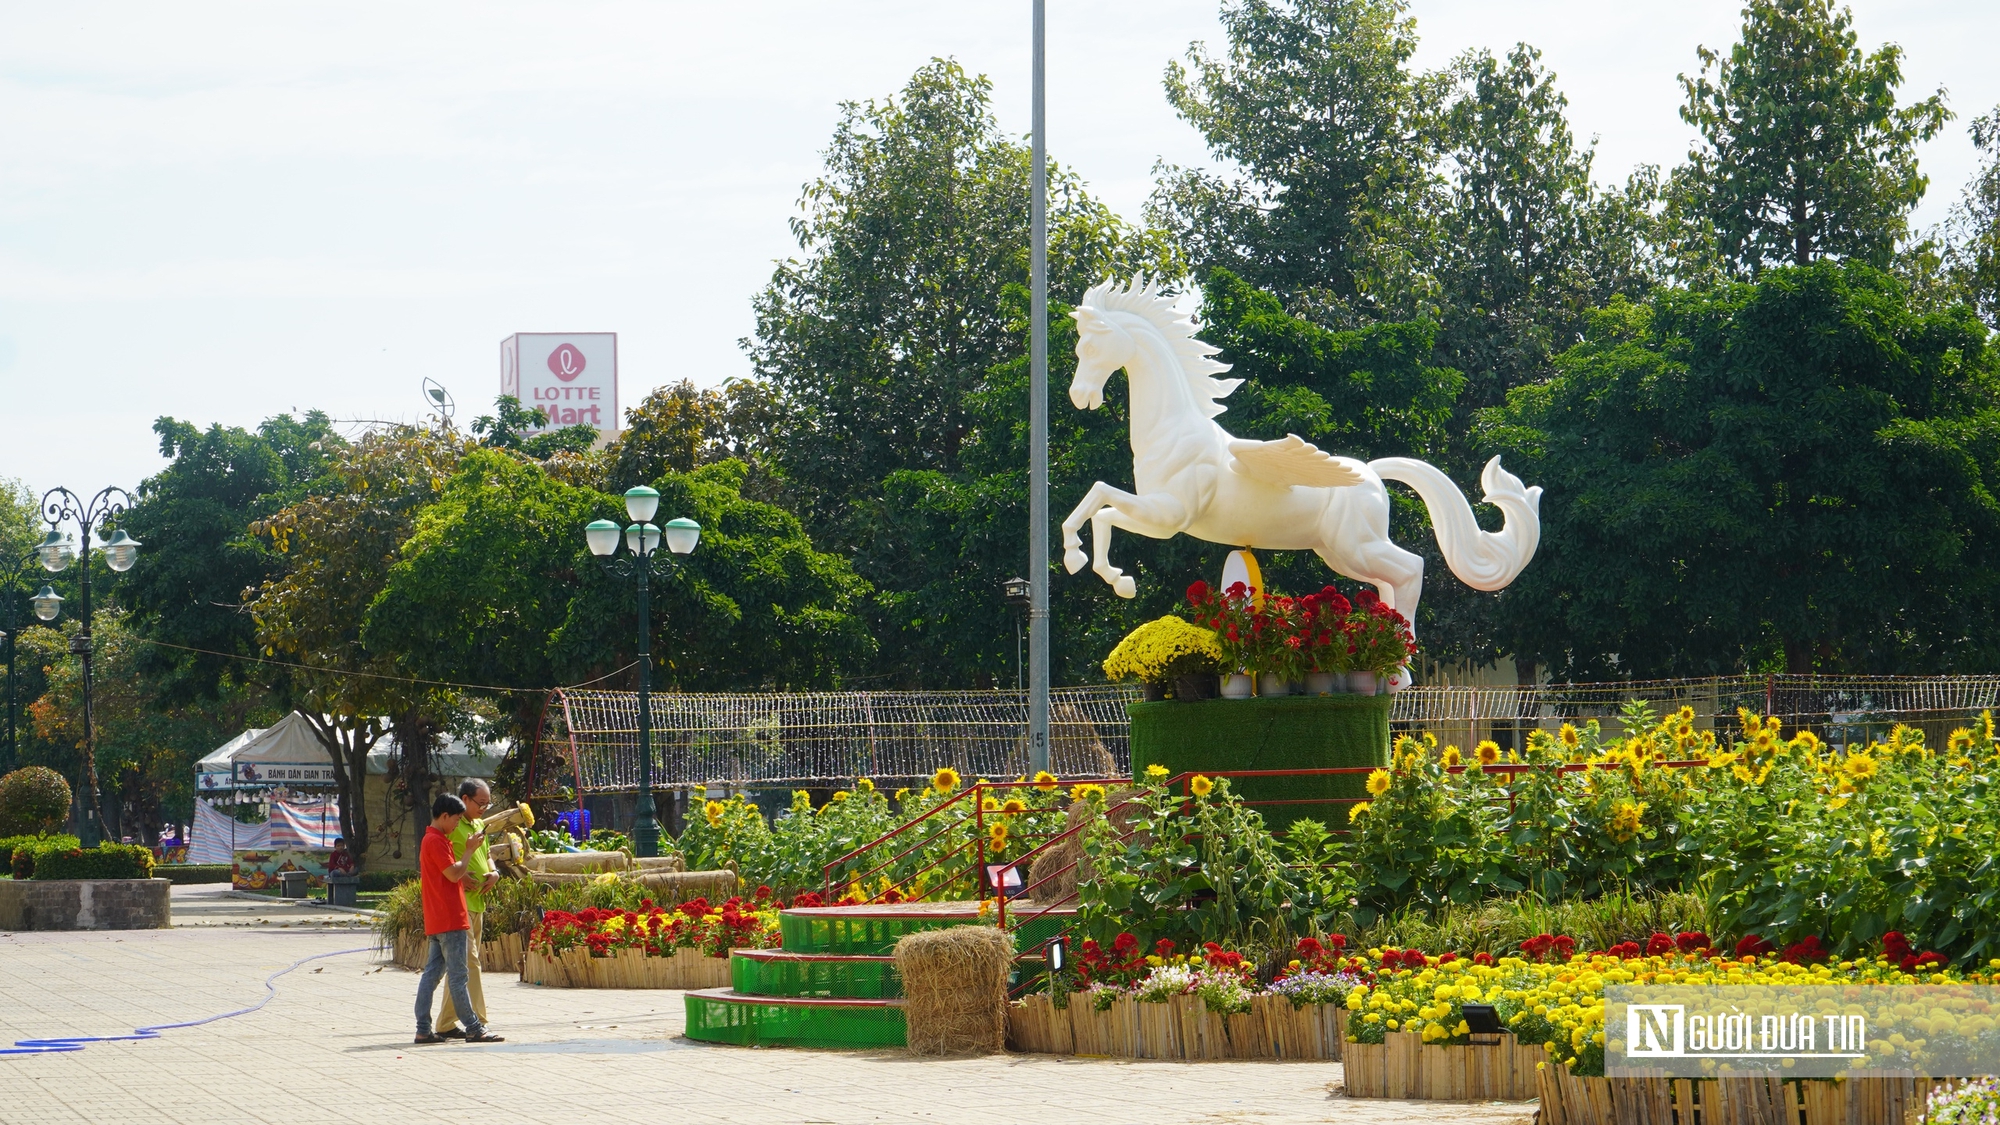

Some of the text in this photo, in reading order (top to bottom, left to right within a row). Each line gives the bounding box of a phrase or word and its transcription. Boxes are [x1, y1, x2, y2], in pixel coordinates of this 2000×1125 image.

[533, 386, 601, 400] LOTTE
[536, 404, 601, 425] Mart
[1030, 731, 1045, 748] 15
[268, 768, 286, 779] BÁNH
[304, 769, 319, 780] GIAN
